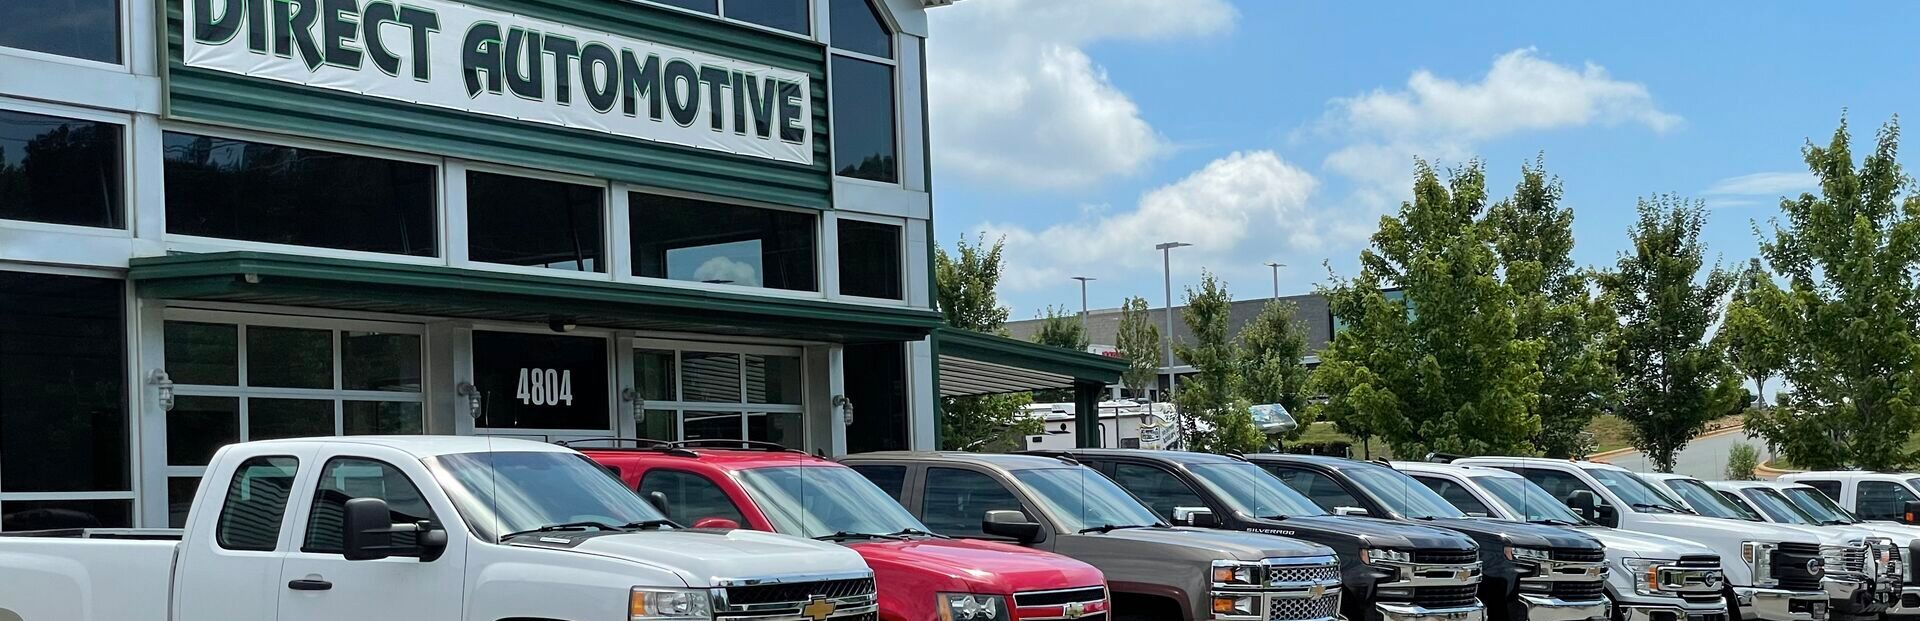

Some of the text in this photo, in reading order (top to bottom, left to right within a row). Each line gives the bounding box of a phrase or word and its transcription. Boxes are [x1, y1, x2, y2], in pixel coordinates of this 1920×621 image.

[193, 0, 807, 144] DIRECT AUTOMOTIVE
[516, 366, 573, 407] 4804
[1247, 527, 1296, 535] SILVERADO
